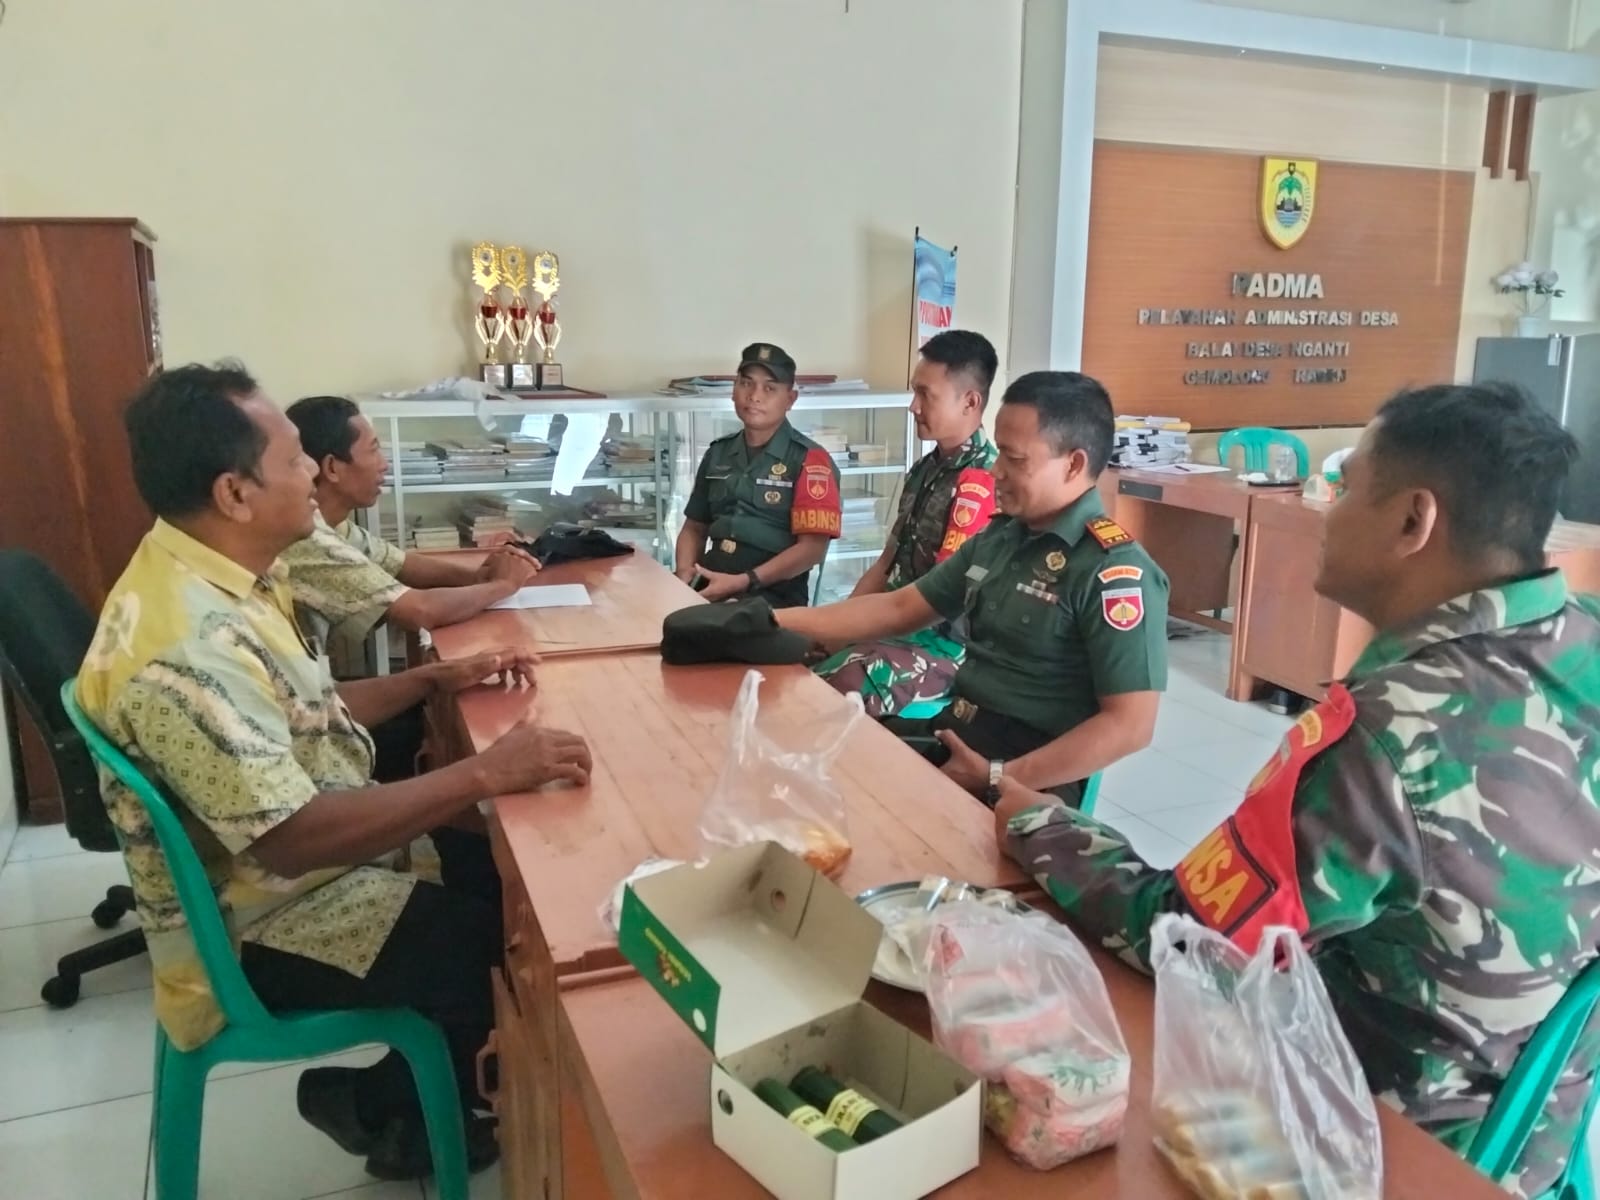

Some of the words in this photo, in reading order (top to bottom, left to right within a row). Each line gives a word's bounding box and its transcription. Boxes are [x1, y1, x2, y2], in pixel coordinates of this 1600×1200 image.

[1232, 272, 1325, 299] PADMA
[1138, 309, 1236, 326] PELAYANAN
[1361, 310, 1399, 327] DESA
[1290, 341, 1349, 358] NGANTI
[791, 508, 840, 531] BABINSA
